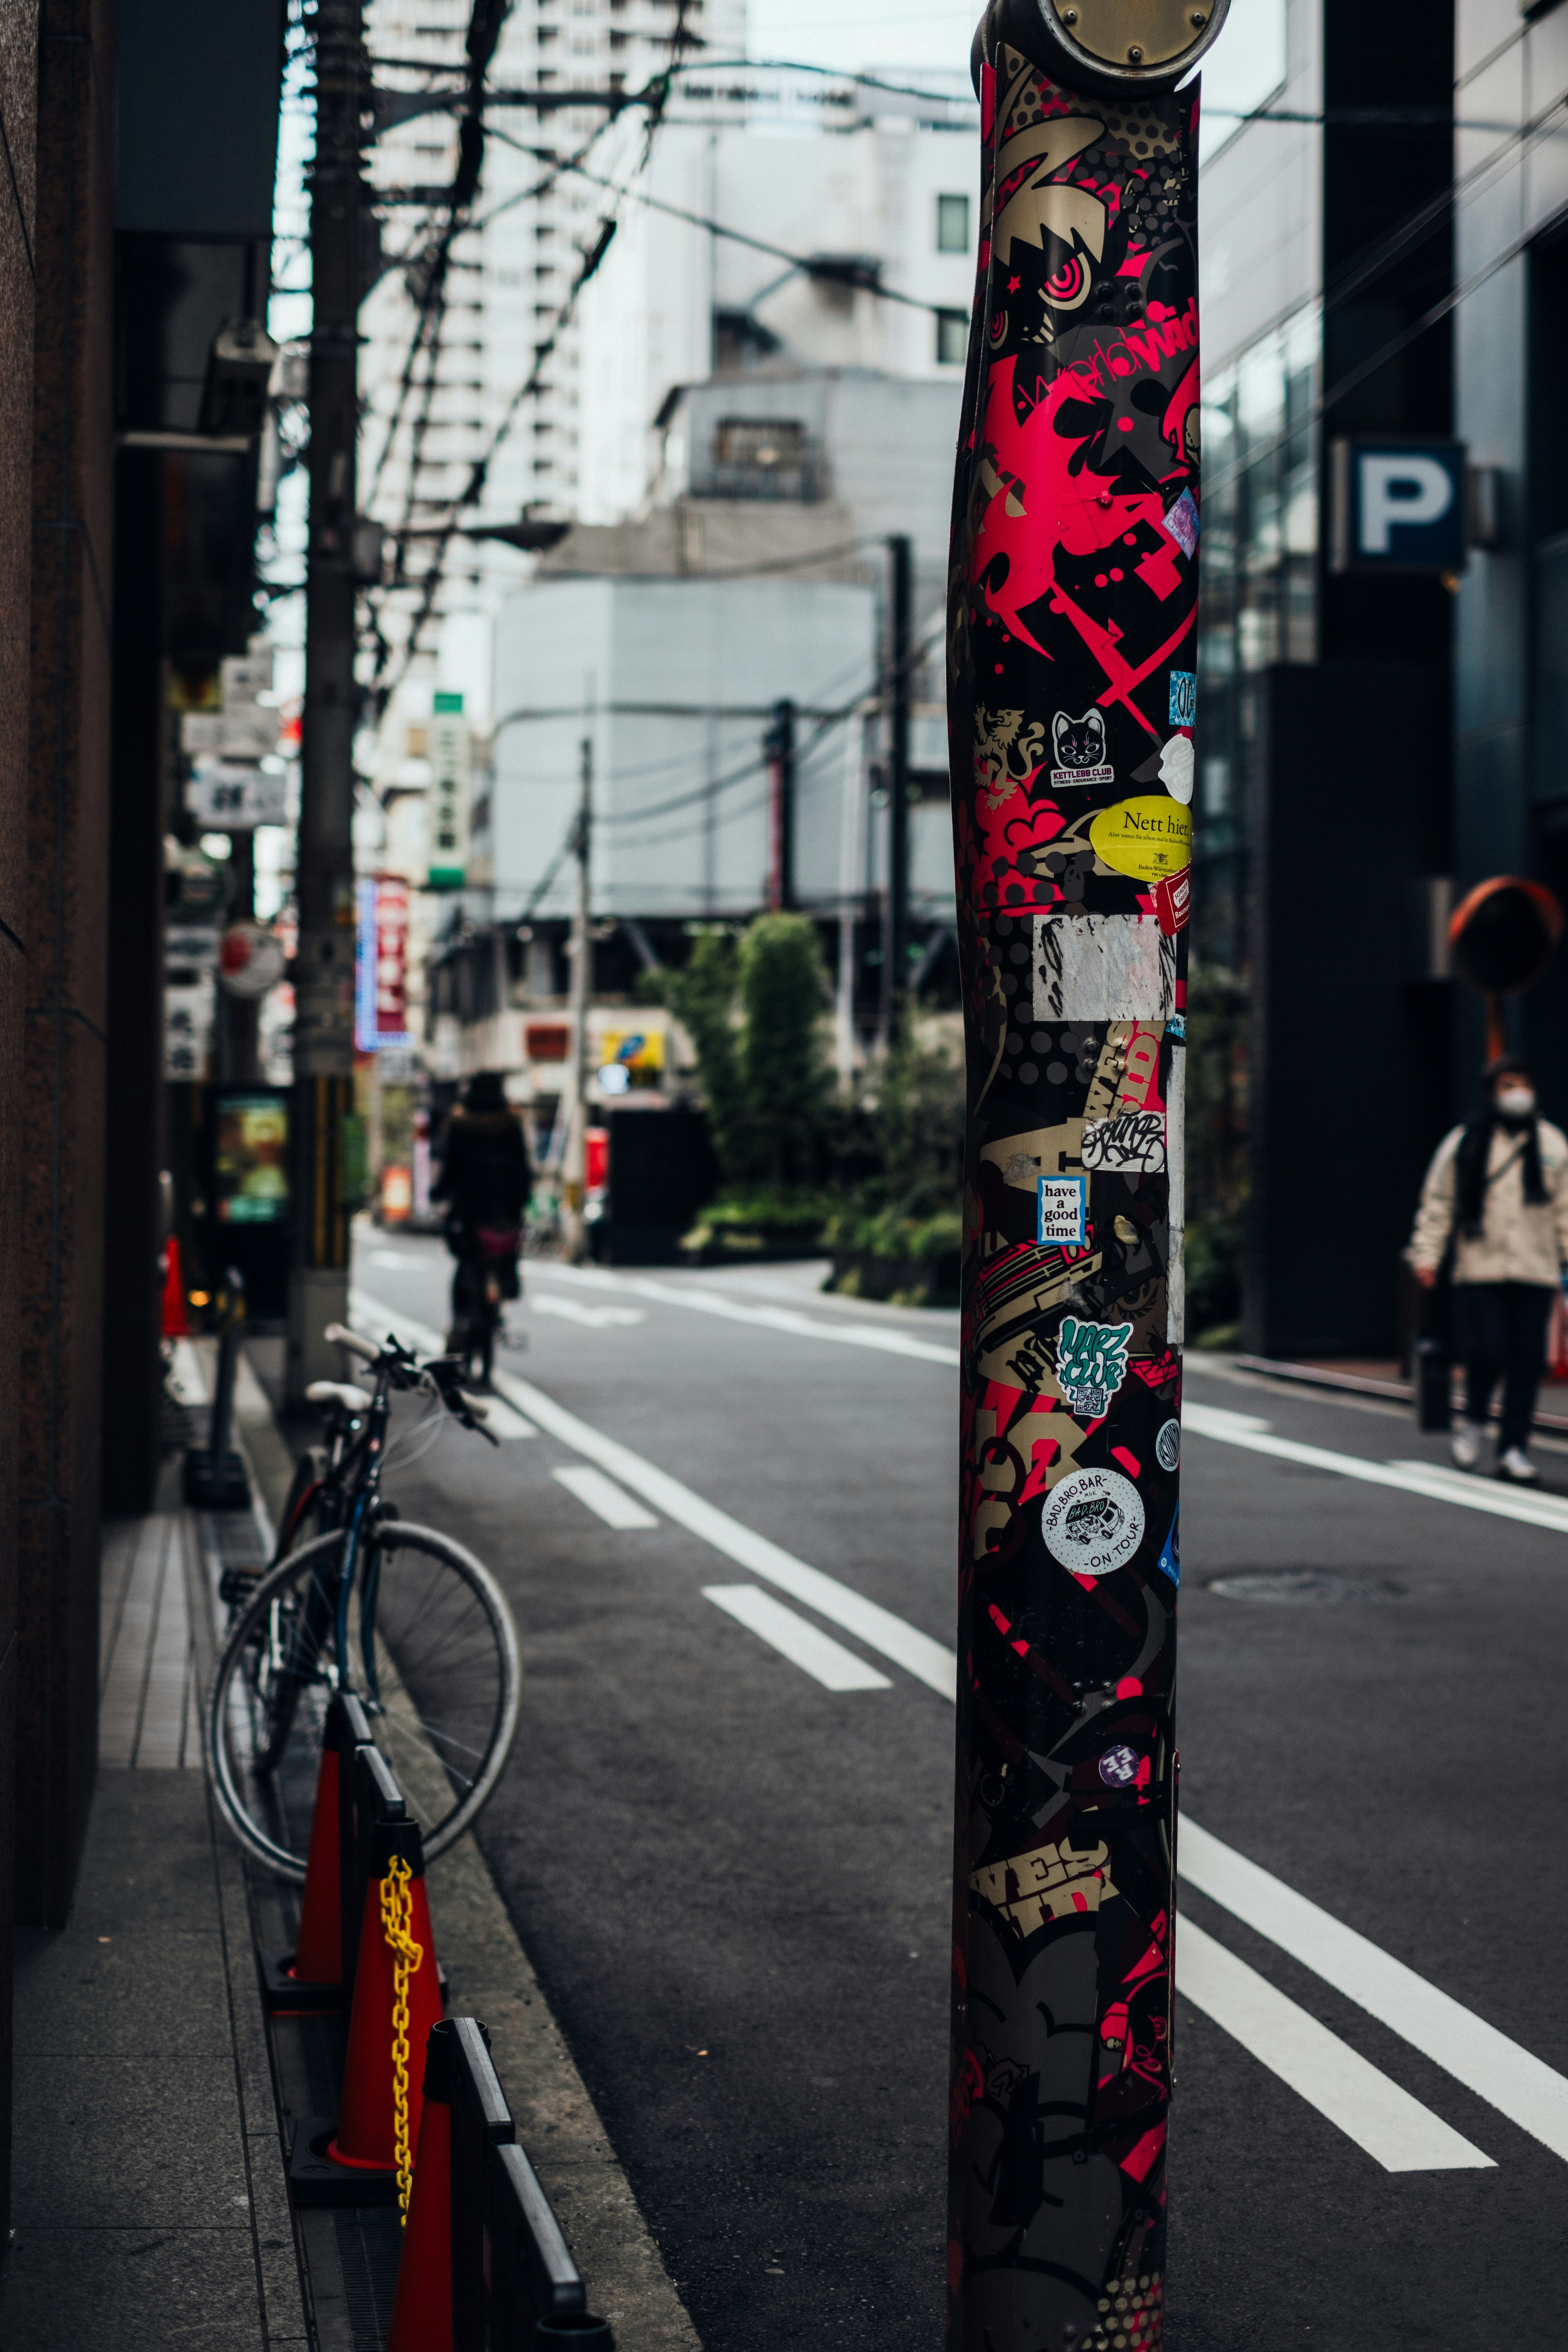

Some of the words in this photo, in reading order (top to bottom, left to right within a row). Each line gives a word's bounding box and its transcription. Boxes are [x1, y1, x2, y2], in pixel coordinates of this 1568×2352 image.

[1360, 454, 1453, 554] P
[1054, 770, 1091, 780] KETTLEBB
[1092, 768, 1111, 776] CLUB
[1123, 811, 1163, 832] Nett
[1167, 815, 1189, 836] hier.
[1174, 881, 1188, 900] SONDER
[1045, 1185, 1076, 1197] have
[1056, 1200, 1065, 1209] a
[1044, 1207, 1078, 1223] good
[1046, 1224, 1076, 1236] time
[1060, 1319, 1130, 1366] MARZ
[1065, 1358, 1120, 1390] CLUB
[1058, 1486, 1078, 1506] BRO
